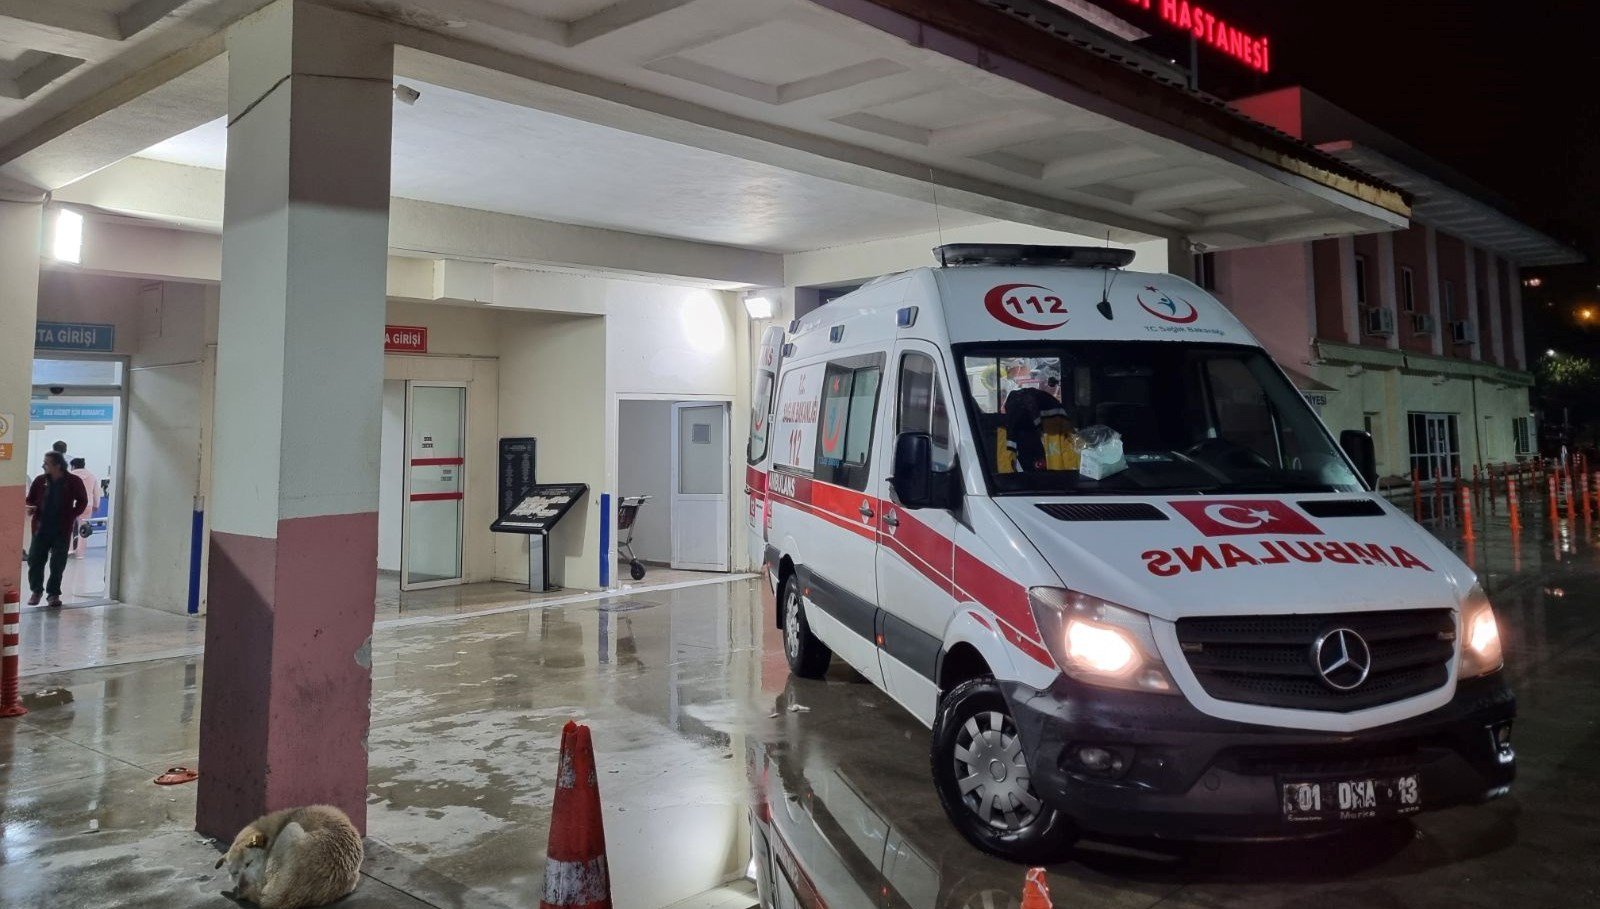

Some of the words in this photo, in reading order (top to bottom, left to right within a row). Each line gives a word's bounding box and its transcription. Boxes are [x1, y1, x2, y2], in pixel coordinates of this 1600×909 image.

[1162, 0, 1269, 73] HASTANESİ
[1006, 295, 1068, 314] 112
[57, 327, 96, 347] GİRİŞİ
[393, 331, 420, 347] GİRİŞİ
[789, 429, 801, 466] 112
